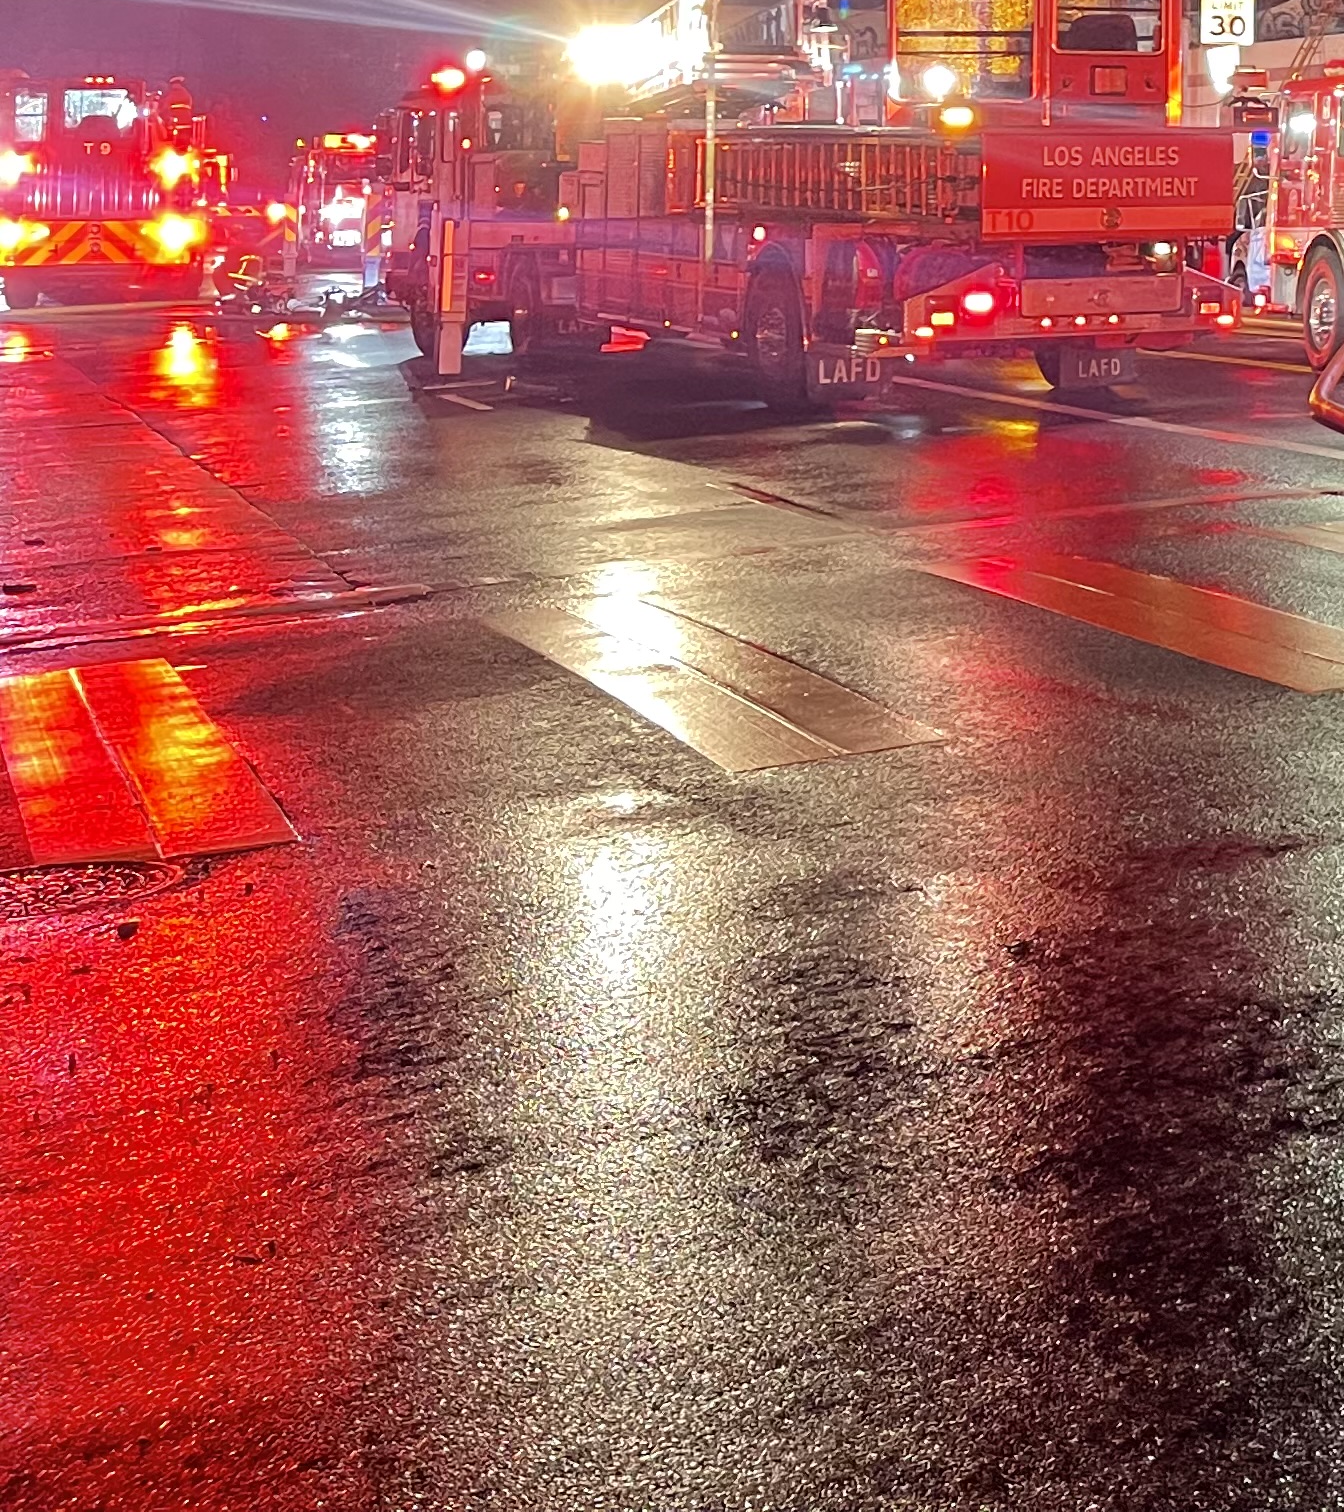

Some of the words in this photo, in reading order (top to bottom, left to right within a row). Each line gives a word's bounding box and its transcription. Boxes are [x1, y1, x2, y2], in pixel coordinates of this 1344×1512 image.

[1211, 1, 1245, 11] LIMIT
[1209, 15, 1246, 36] 30
[84, 142, 94, 155] T
[100, 142, 112, 155] 9
[1043, 146, 1083, 167] LOS
[1091, 146, 1180, 167] ANGELES
[1021, 178, 1064, 199] FIRE
[1073, 177, 1199, 199] DEPARTMENT
[987, 210, 1035, 232] T10
[819, 358, 881, 384] LAFD
[1078, 358, 1121, 379] LAFD
